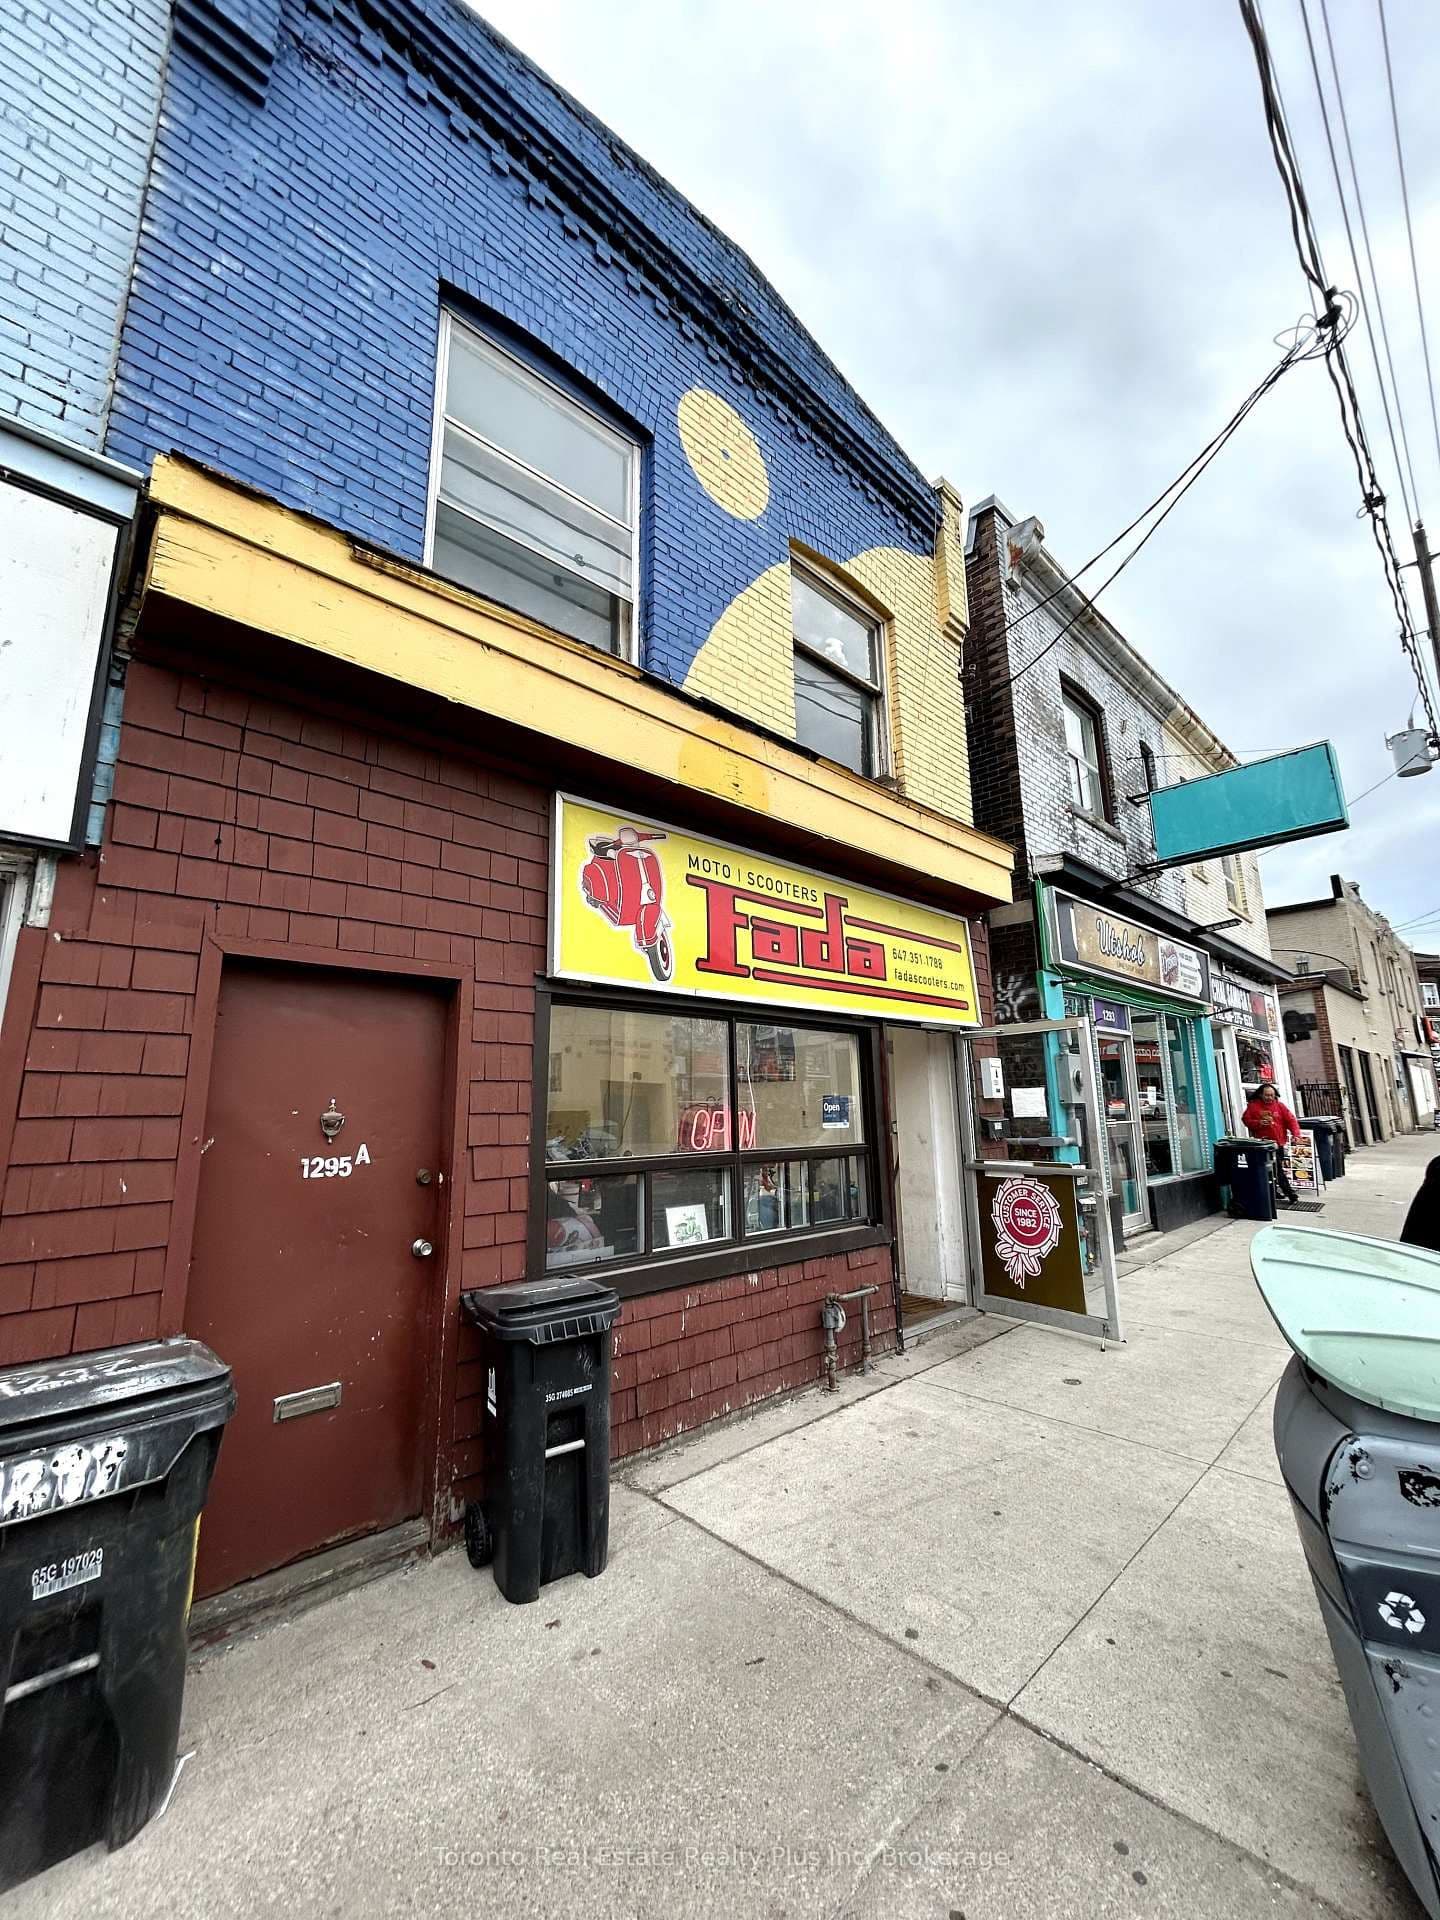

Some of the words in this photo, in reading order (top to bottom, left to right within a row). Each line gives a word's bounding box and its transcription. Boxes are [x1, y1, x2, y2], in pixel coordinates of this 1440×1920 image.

[688, 854, 731, 879] MOTO
[747, 872, 818, 902] SCOOTERS
[684, 874, 887, 981] Fada
[894, 968, 965, 992] fadascooters.com
[1102, 1009, 1116, 1023] 1293
[823, 1102, 840, 1113] Open
[691, 1110, 757, 1150] OPN
[1002, 1188, 1028, 1224] CUSTOMER
[1030, 1192, 1051, 1229] SERVICE
[1014, 1208, 1038, 1218] SINCE
[1016, 1218, 1037, 1228] 1982
[31, 1563, 57, 1587] 65G
[61, 1547, 104, 1577] 197029
